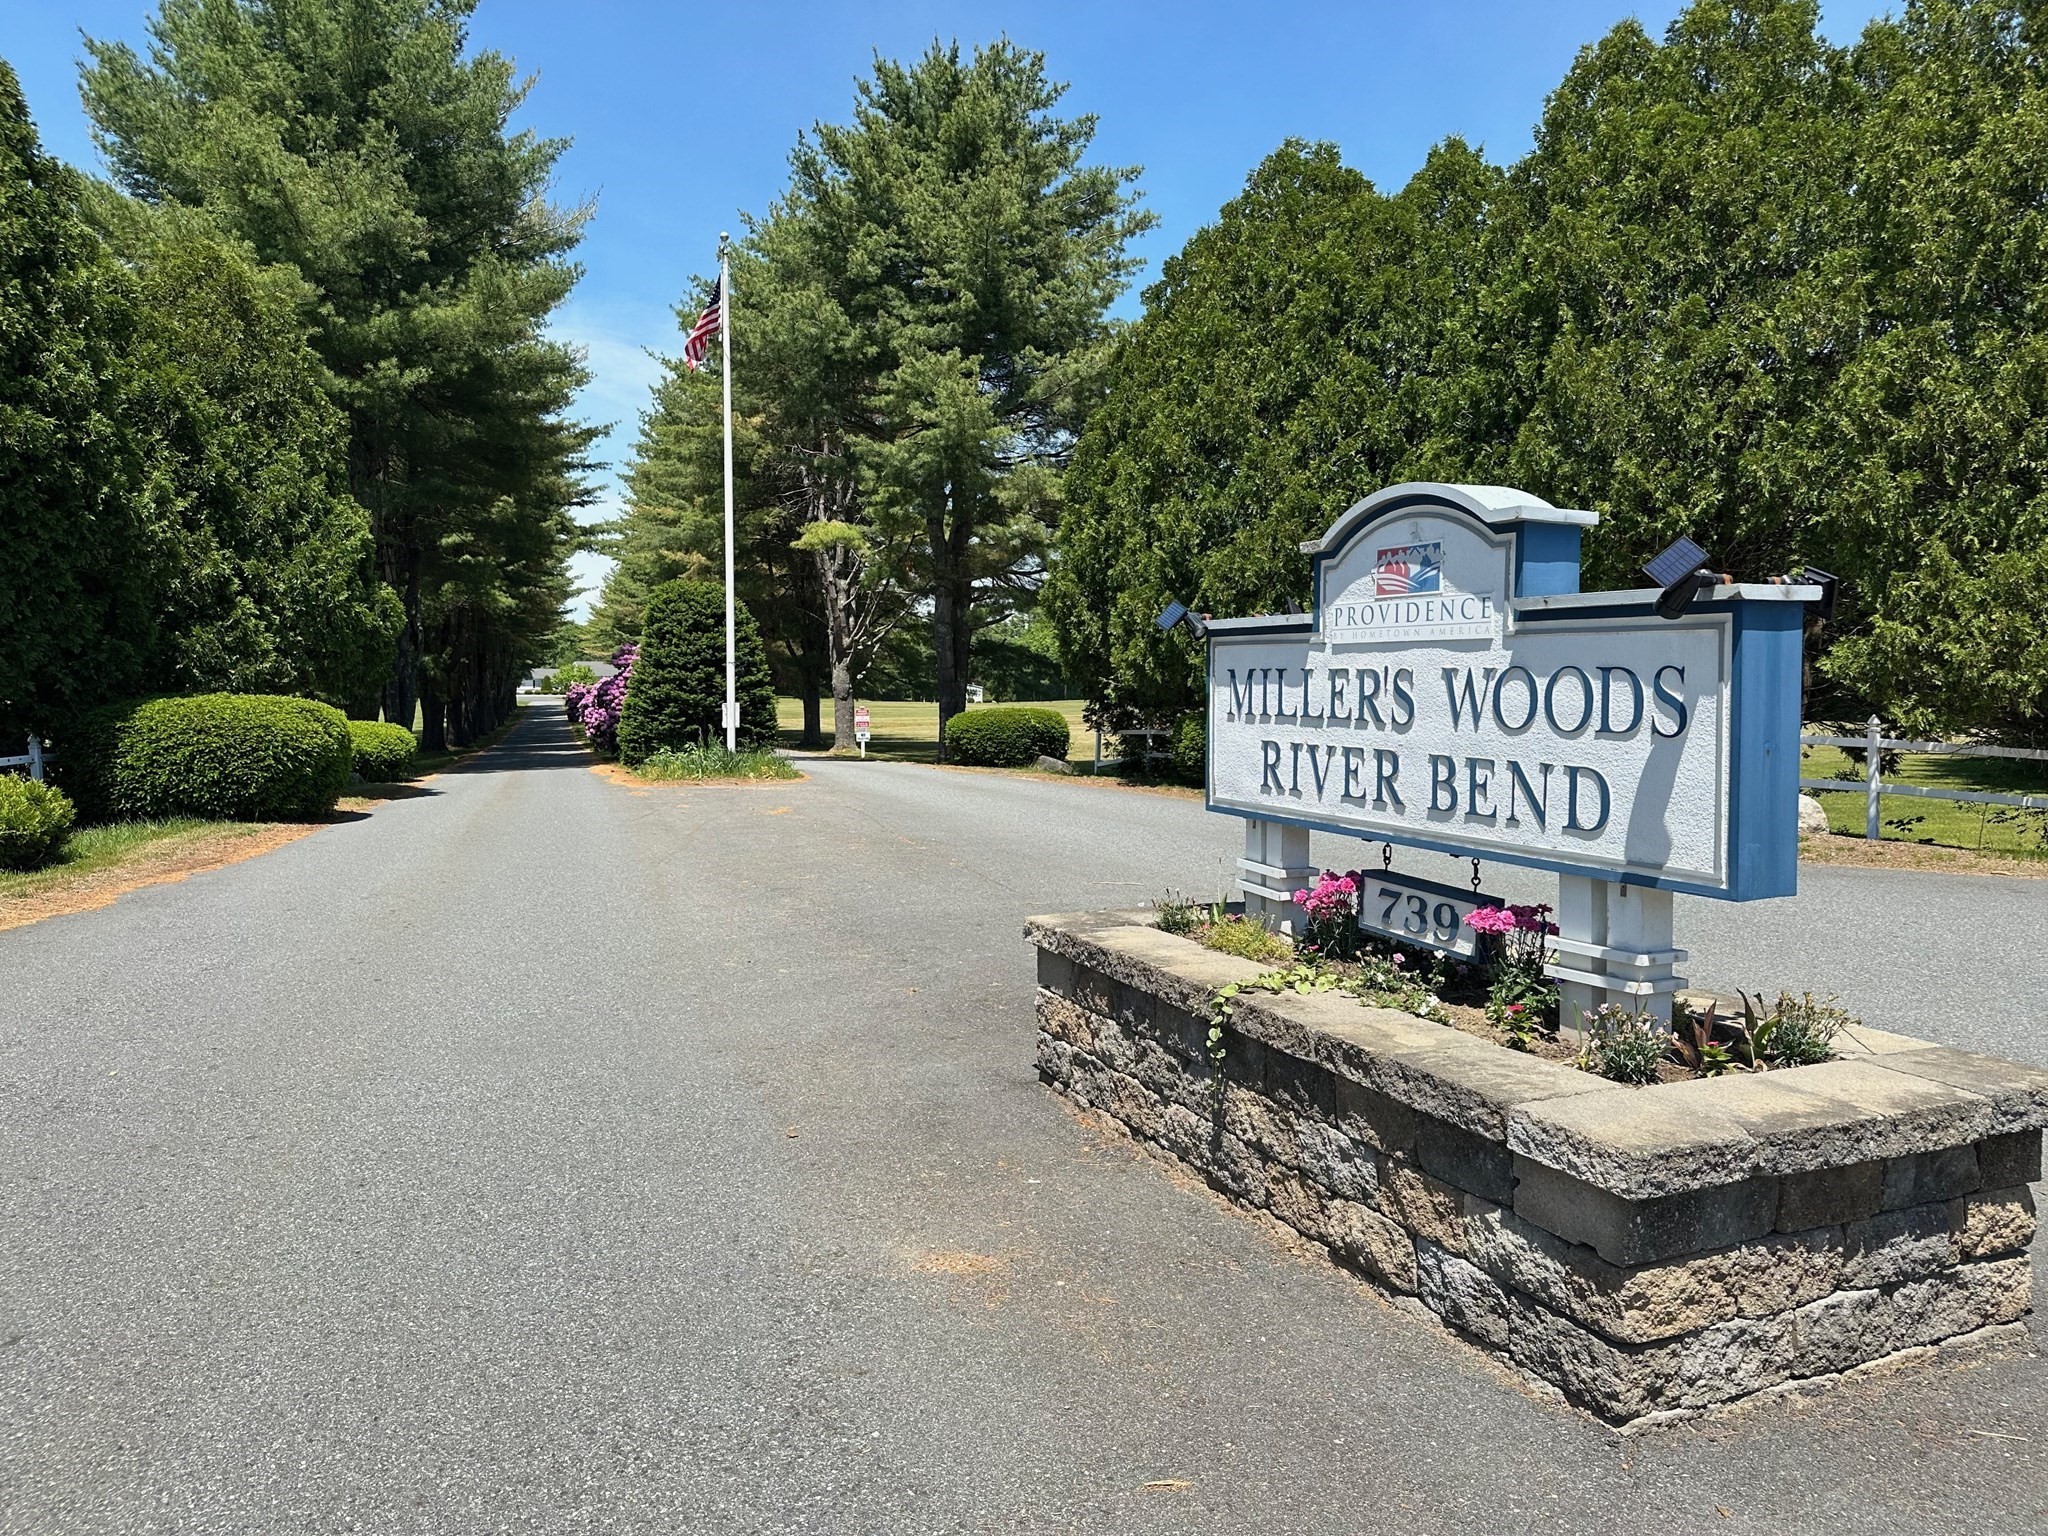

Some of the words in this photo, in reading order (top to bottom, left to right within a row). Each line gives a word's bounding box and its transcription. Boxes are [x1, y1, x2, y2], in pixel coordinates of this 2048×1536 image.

[1333, 632, 1344, 640] BY
[1352, 628, 1421, 640] HOMETOWN
[1429, 625, 1491, 637] AMERICA
[1334, 596, 1491, 627] PROVIDENCE
[1226, 665, 1415, 726] MILLER'S
[1441, 664, 1688, 739] WOODS
[1260, 740, 1405, 807] RIVER
[1427, 753, 1611, 832] BEND
[1378, 887, 1460, 942] 739
